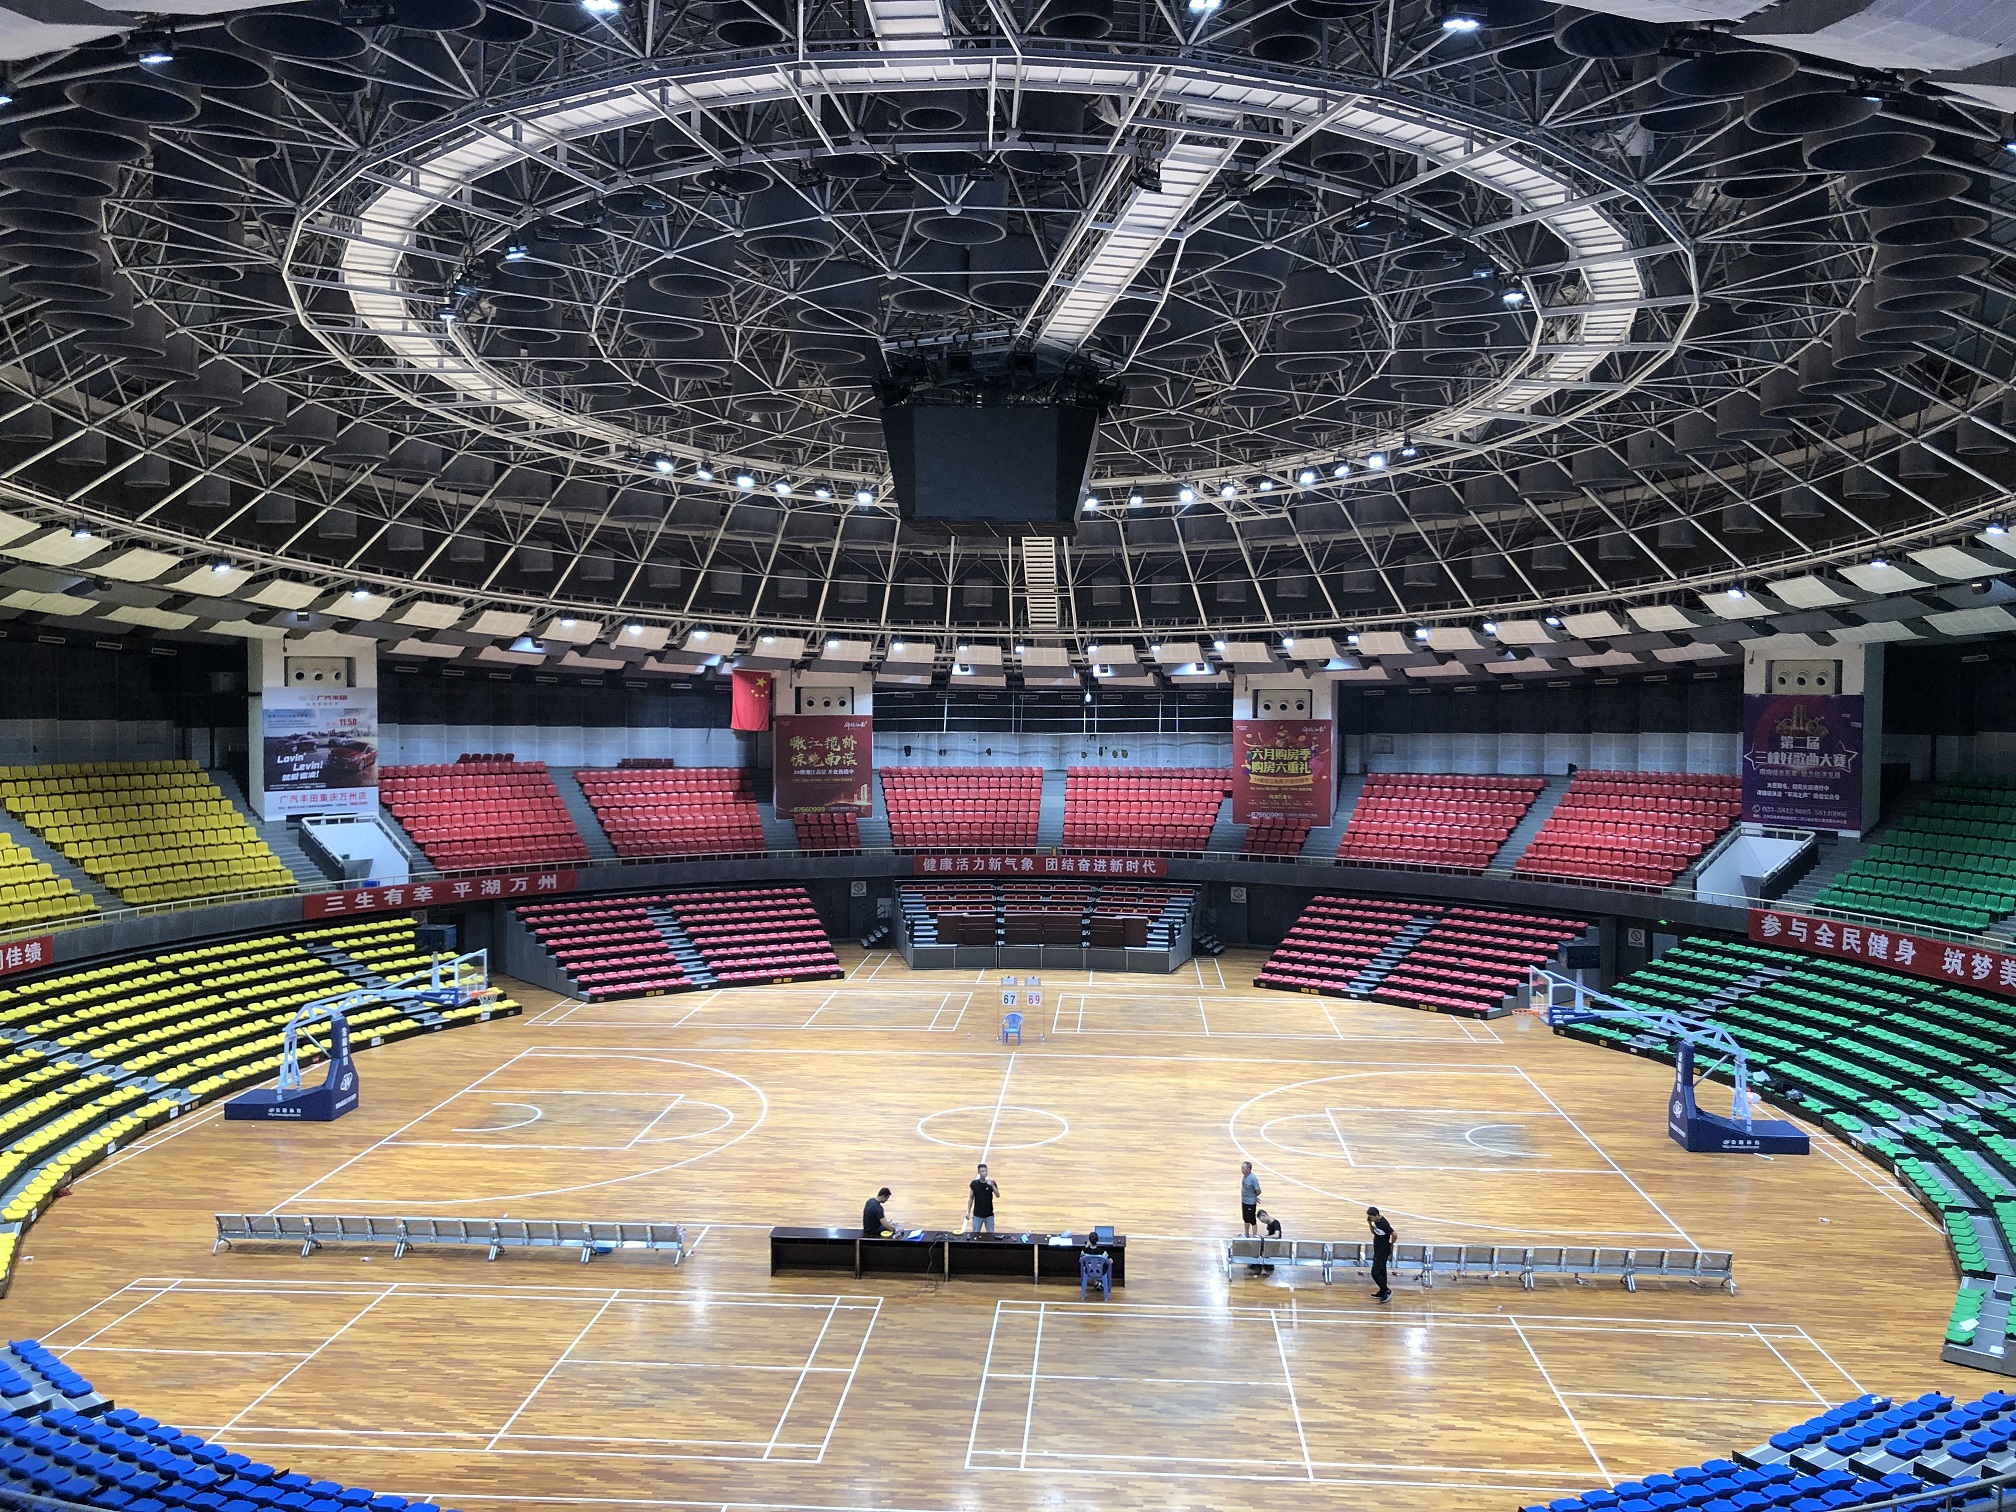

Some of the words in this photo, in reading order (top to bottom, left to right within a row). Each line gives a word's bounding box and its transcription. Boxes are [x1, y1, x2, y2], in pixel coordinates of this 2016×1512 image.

[1780, 736, 1820, 750] 第二届
[1251, 748, 1312, 761] 六月购房季
[1755, 751, 1847, 768] 三峡好歌曲大赛
[293, 760, 324, 772] Levin!
[1251, 761, 1311, 774] 购房六重礼
[280, 791, 367, 804] 广汽丰田重庆万州店
[923, 857, 1035, 873] 健康活力新气象
[1045, 857, 1157, 874] 团结奋进新时代
[324, 885, 434, 913] 三生有幸
[452, 873, 557, 899] 平湖万州
[0, 941, 42, 971] 佳绩
[1760, 913, 1917, 966] 参与全民健身
[1941, 946, 2016, 989] 筑梦美
[1003, 994, 1016, 1005] 67
[1028, 994, 1041, 1005] 69
